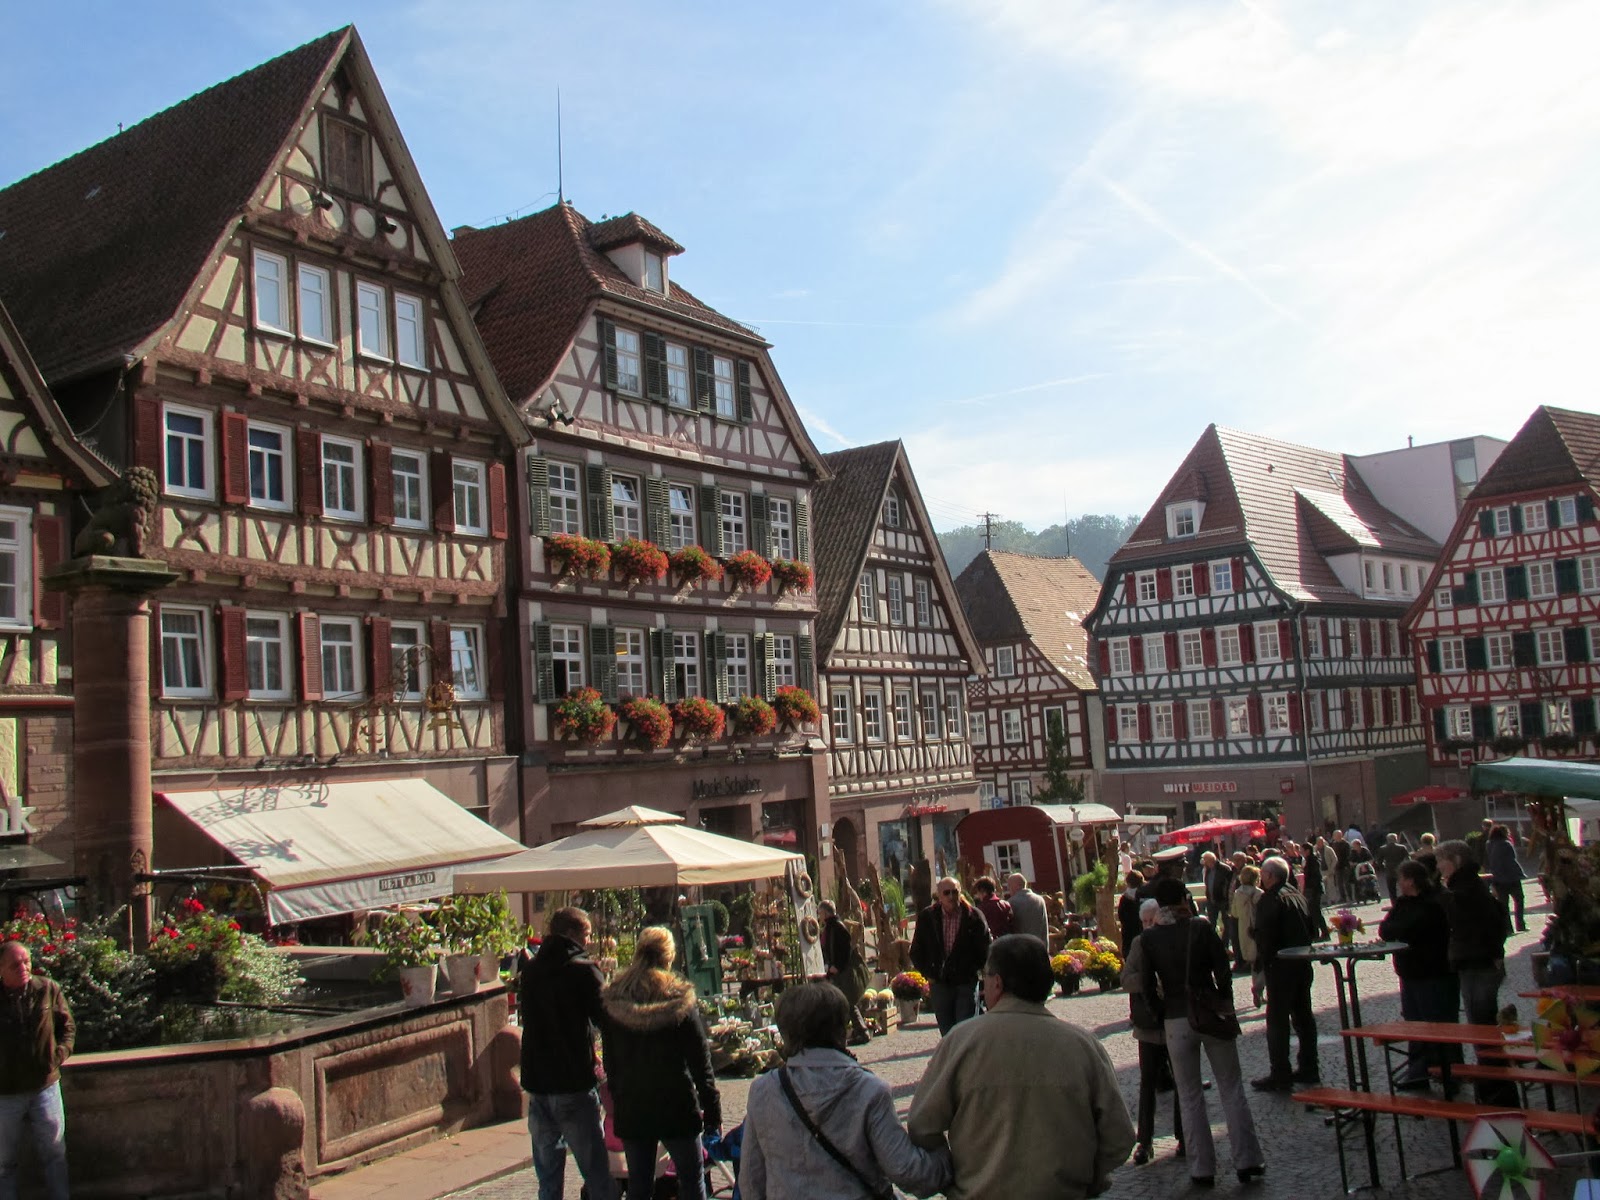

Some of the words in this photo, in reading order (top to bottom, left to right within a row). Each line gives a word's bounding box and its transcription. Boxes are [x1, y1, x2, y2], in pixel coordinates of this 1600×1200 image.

[1163, 783, 1190, 793] WITT
[1192, 781, 1237, 793] WEIDEN
[994, 798, 1001, 808] P
[381, 876, 405, 890] BETT
[406, 878, 413, 886] &
[415, 873, 434, 885] BAD
